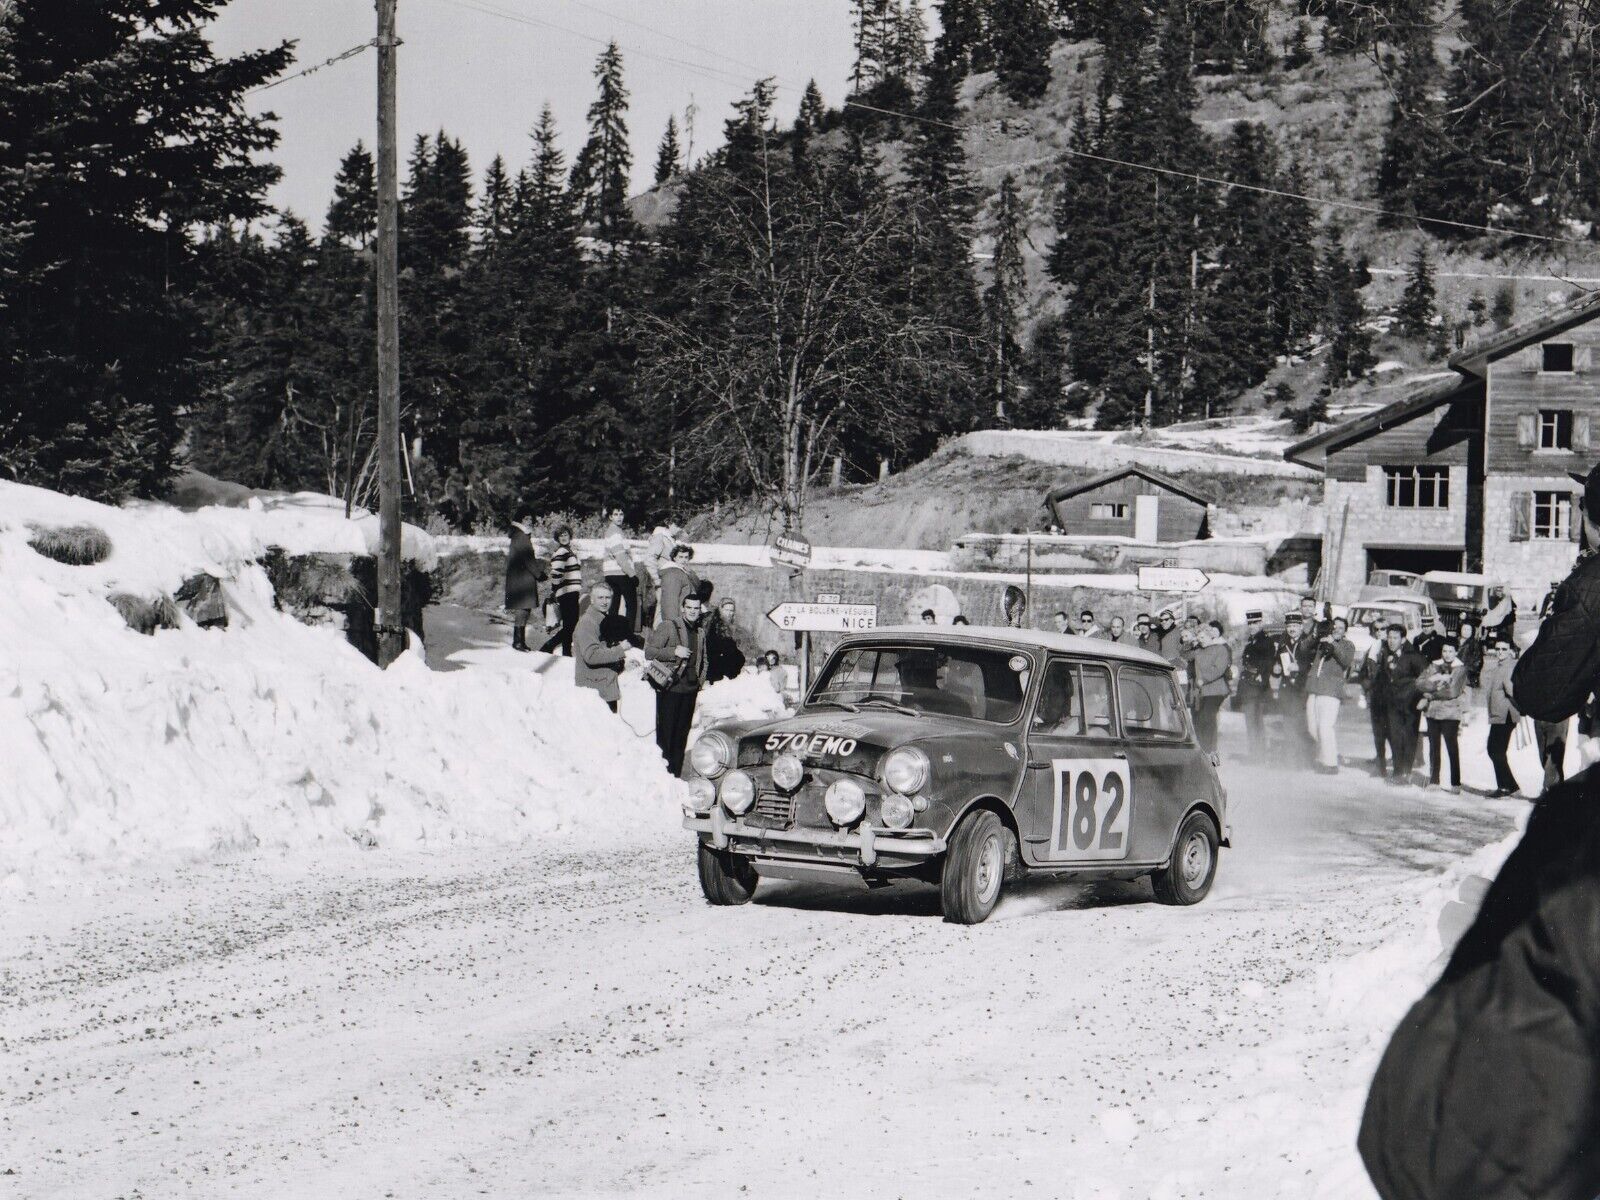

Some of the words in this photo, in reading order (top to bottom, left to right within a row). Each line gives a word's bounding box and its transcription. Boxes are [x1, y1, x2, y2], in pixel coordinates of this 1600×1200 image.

[797, 606, 806, 614] LA
[783, 616, 796, 626] 67
[842, 617, 873, 628] NICE
[765, 734, 808, 750] 570
[807, 734, 857, 757] EMO
[1058, 771, 1124, 851] 182
